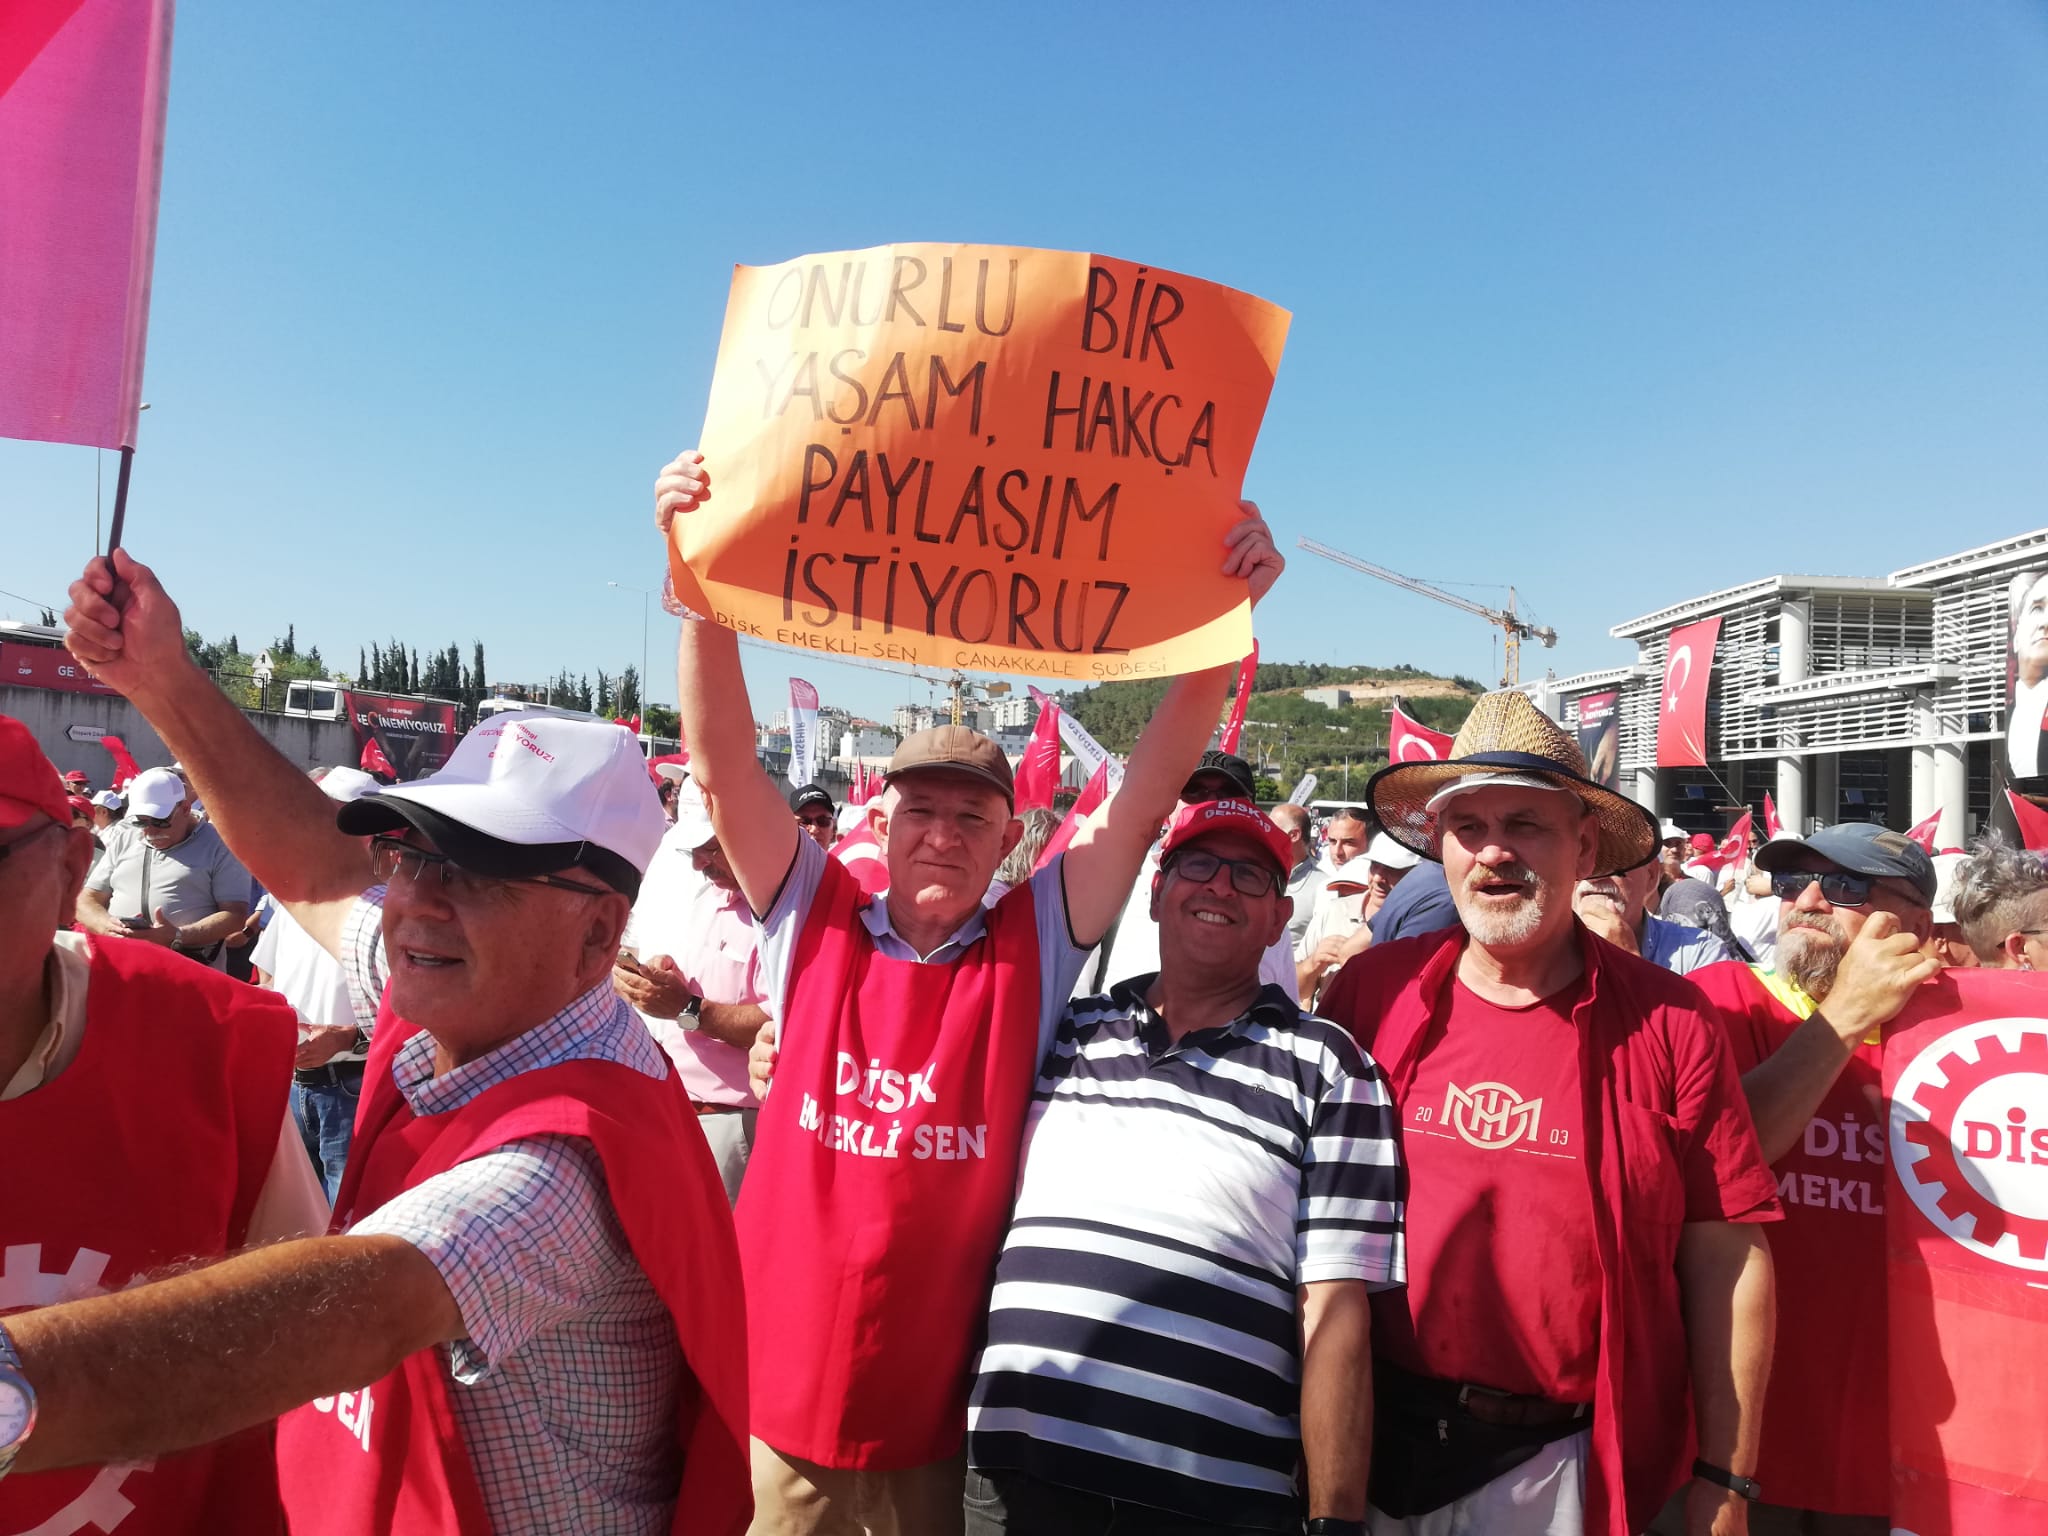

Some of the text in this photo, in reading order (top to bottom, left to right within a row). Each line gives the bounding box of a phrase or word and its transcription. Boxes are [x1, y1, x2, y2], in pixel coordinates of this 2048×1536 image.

[768, 255, 1184, 370] ONURLU BİR
[756, 348, 1218, 477] YAŞAM, HAKÇA
[797, 443, 1121, 563] PAYLAŞIM
[782, 534, 1131, 656] İSTİYORUZ
[716, 611, 1167, 680] DİSK EMEKLİ-SEN ÇANAKKALE ŞUBESİ
[836, 1051, 937, 1114] DİSK
[1415, 1106, 1433, 1122] 20
[912, 1123, 987, 1161] SEN
[1550, 1128, 1569, 1146] 03
